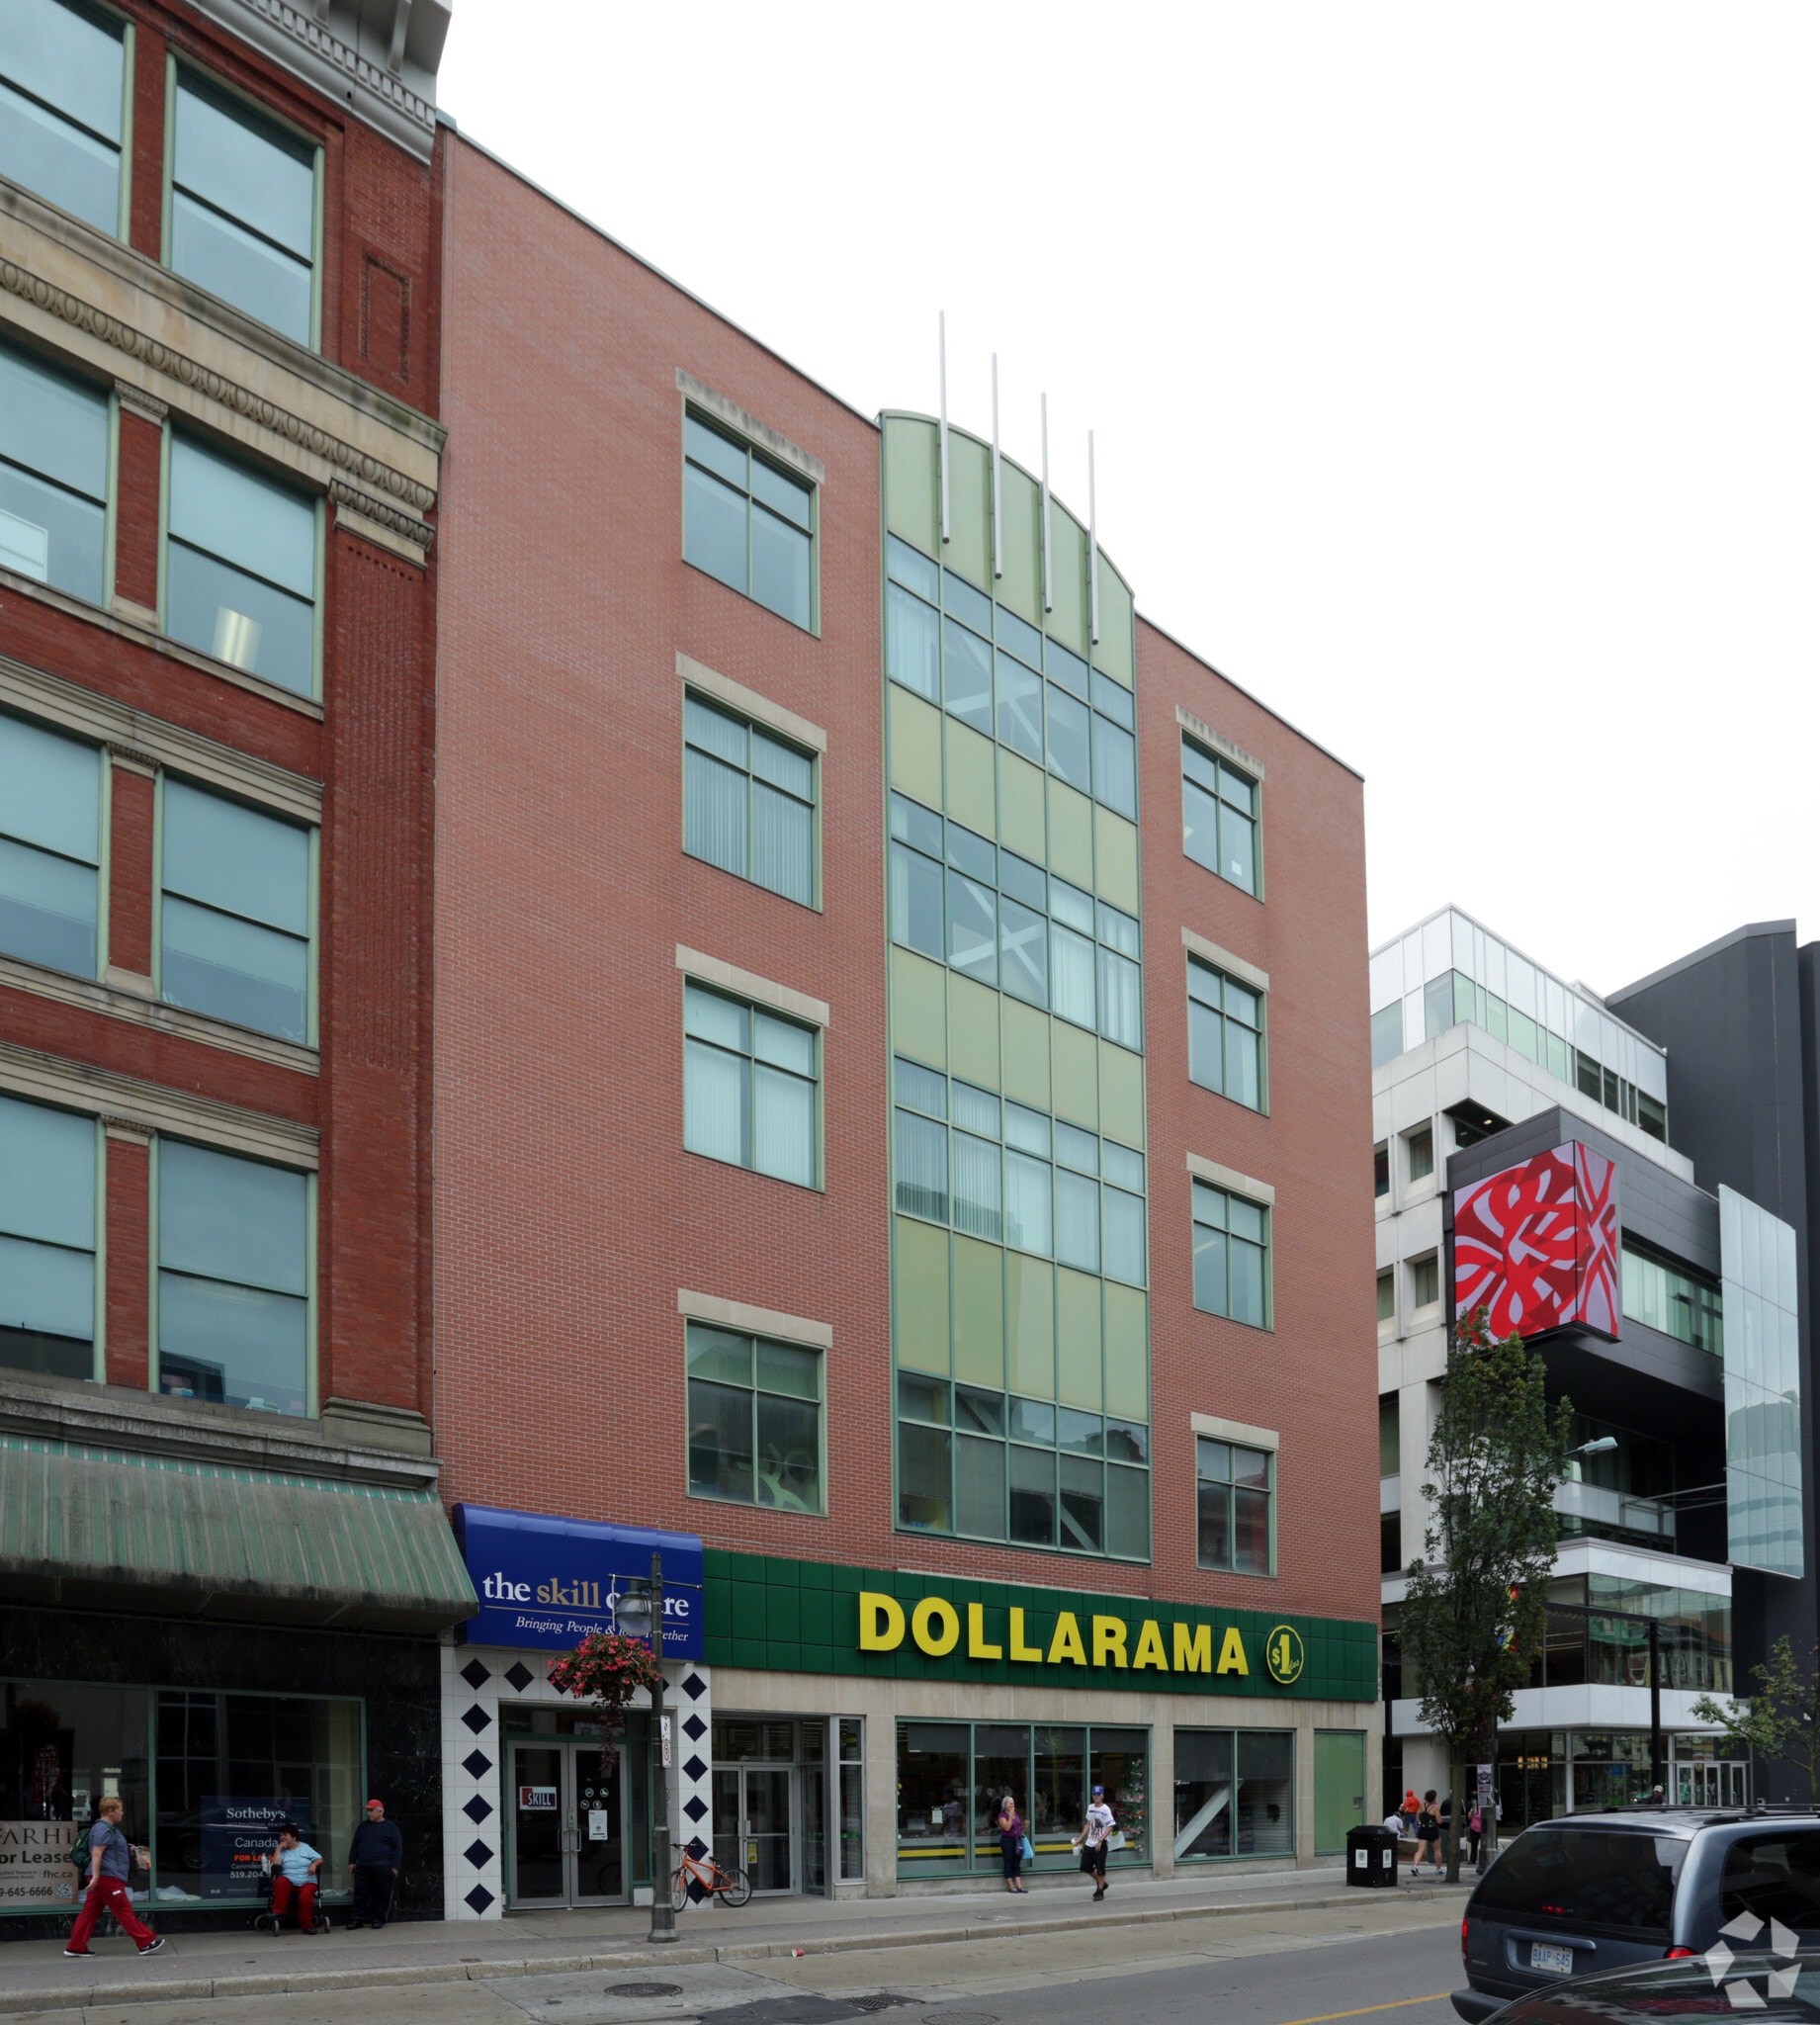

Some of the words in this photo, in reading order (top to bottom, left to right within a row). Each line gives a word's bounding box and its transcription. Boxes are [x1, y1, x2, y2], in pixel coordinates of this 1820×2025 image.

[482, 1572, 531, 1602] the
[537, 1578, 601, 1609] skill
[606, 1591, 690, 1617] cre
[515, 1616, 563, 1634] Bringing
[566, 1621, 602, 1637] People
[604, 1625, 615, 1635] &
[858, 1591, 1250, 1676] DOLLARAMA
[527, 1793, 552, 1806] SKILL
[226, 1806, 287, 1821] Sotheby's
[0, 1827, 74, 1845] ARHI
[234, 1837, 279, 1848] Canada
[22, 1850, 72, 1864] Lease
[43, 1870, 73, 1879] fhc.ca
